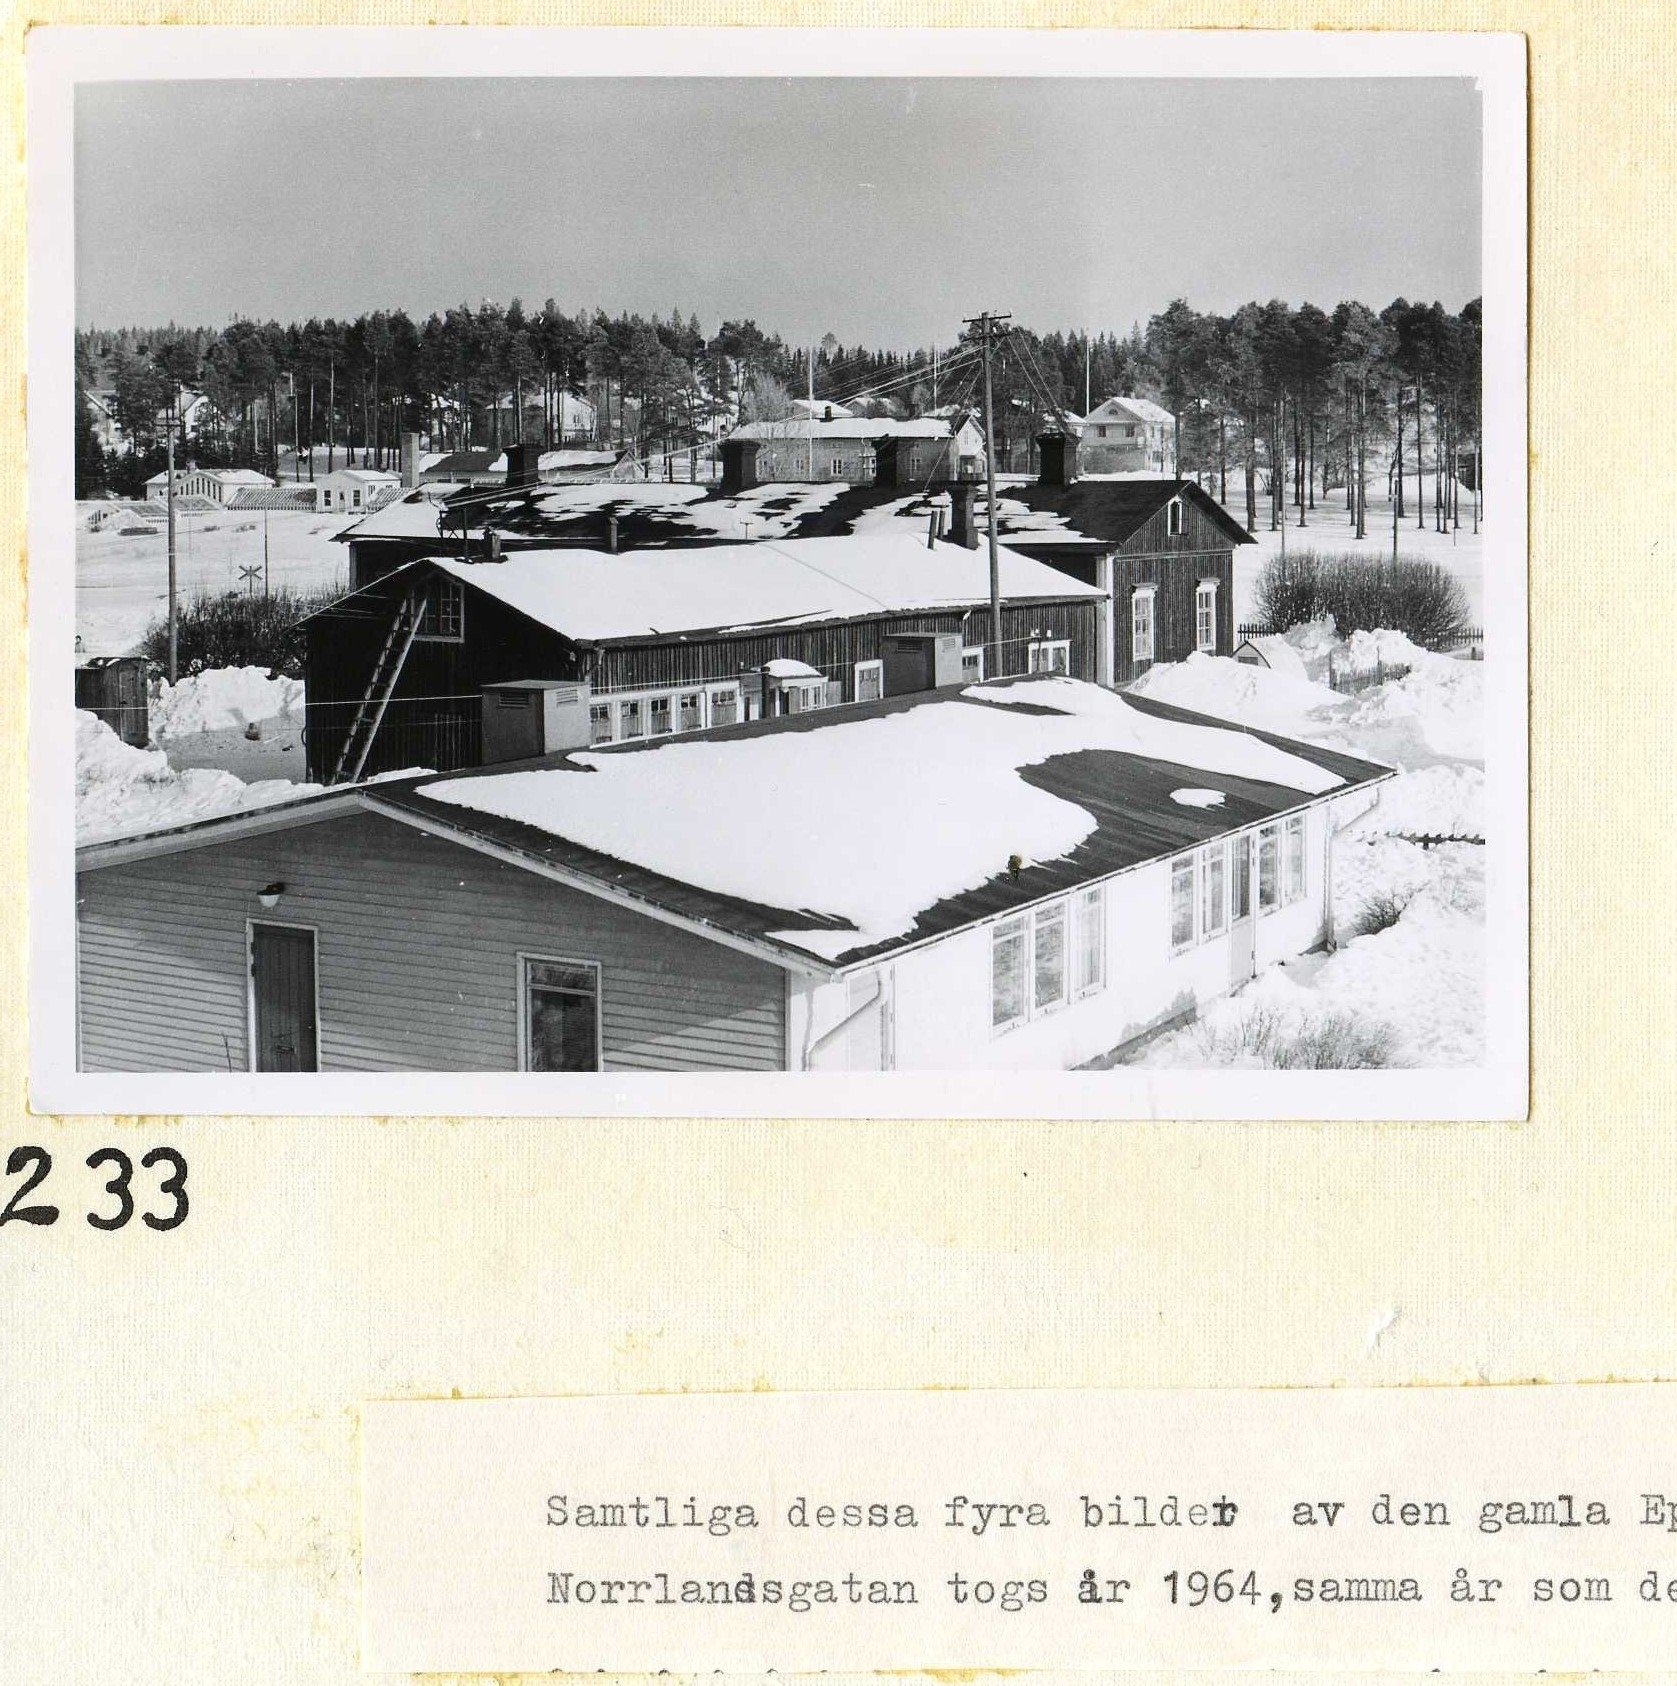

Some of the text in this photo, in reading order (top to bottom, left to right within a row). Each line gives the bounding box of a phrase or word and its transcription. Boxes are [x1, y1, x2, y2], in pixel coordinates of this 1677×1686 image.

[0, 1145, 190, 1231] 233
[547, 1495, 759, 1537] Samtliga
[787, 1496, 919, 1528] dessa
[945, 1495, 1051, 1536] fyra
[1292, 1502, 1345, 1527] av
[1371, 1493, 1451, 1527] den
[1478, 1494, 1610, 1534] gamla
[547, 1572, 919, 1613] Norrlandsgatan
[946, 1572, 1048, 1612] togs
[1078, 1568, 1131, 1604] år
[1450, 1567, 1503, 1602] år
[1533, 1578, 1613, 1602] som
